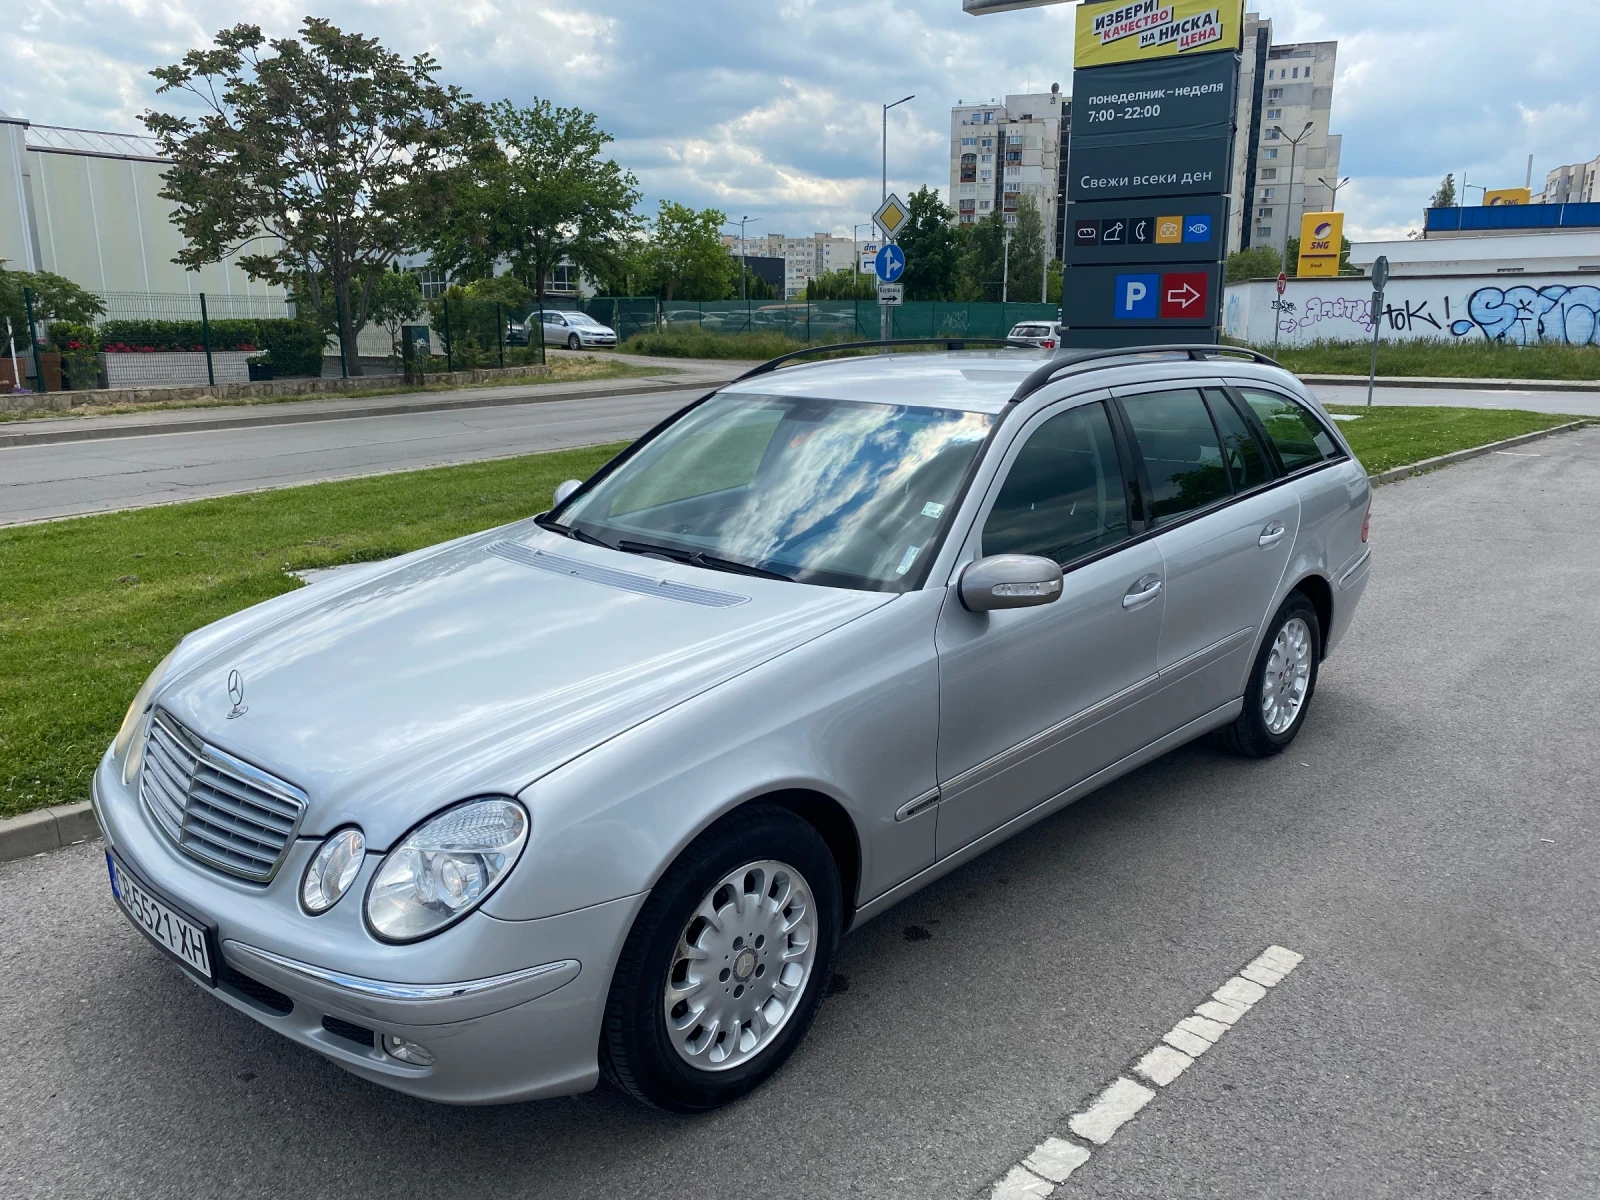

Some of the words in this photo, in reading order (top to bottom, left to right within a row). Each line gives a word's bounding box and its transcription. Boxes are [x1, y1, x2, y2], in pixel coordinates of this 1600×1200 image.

[1095, 0, 1154, 30] ИЗБЕРИ
[1103, 10, 1169, 40] КАЧЕСТВО
[1141, 32, 1155, 44] НА
[1159, 13, 1213, 41] НИСКА
[1180, 27, 1216, 47] ЦЕНА
[1080, 175, 1129, 189] Свежи
[1133, 172, 1177, 185] всеки
[1181, 171, 1212, 184] ден
[864, 243, 877, 251] dm
[1310, 241, 1330, 250] SNG
[1125, 281, 1147, 311] P
